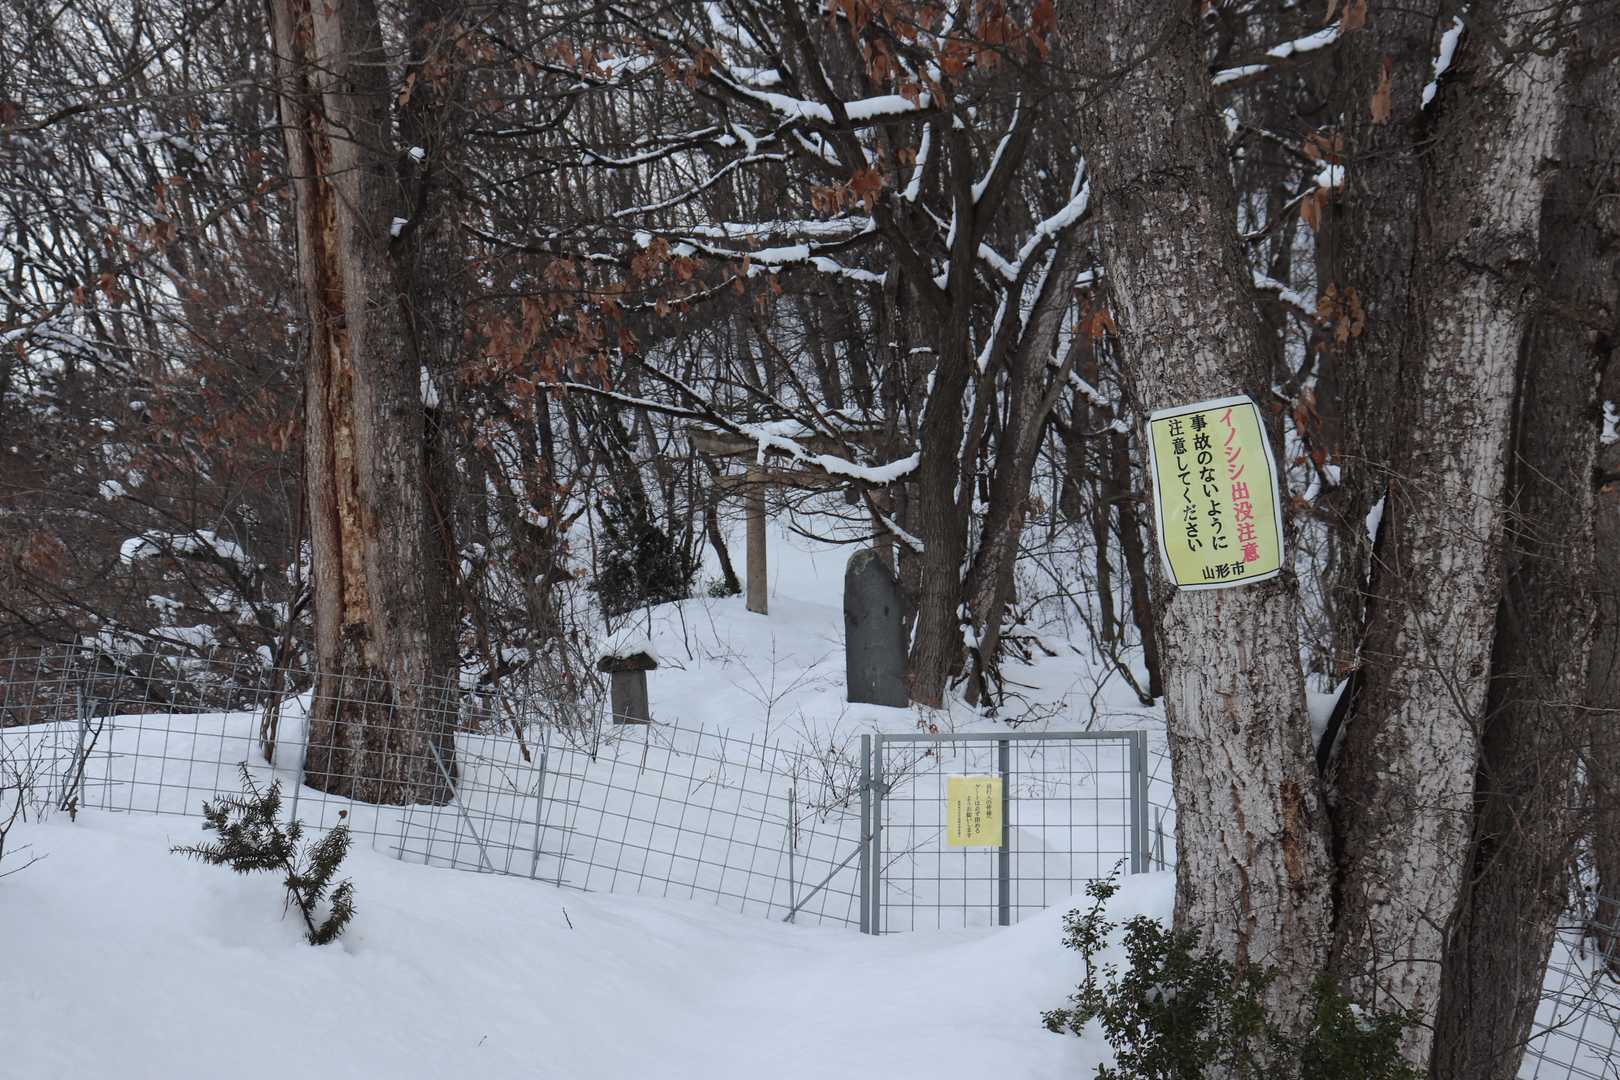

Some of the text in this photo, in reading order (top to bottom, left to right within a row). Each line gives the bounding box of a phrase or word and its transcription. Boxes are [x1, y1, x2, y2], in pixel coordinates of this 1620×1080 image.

[1168, 419, 1203, 552] 注意してください
[1190, 414, 1228, 551] 事故のないように
[1219, 408, 1260, 563] イノシシ出没注意
[1202, 561, 1245, 580] 山形市
